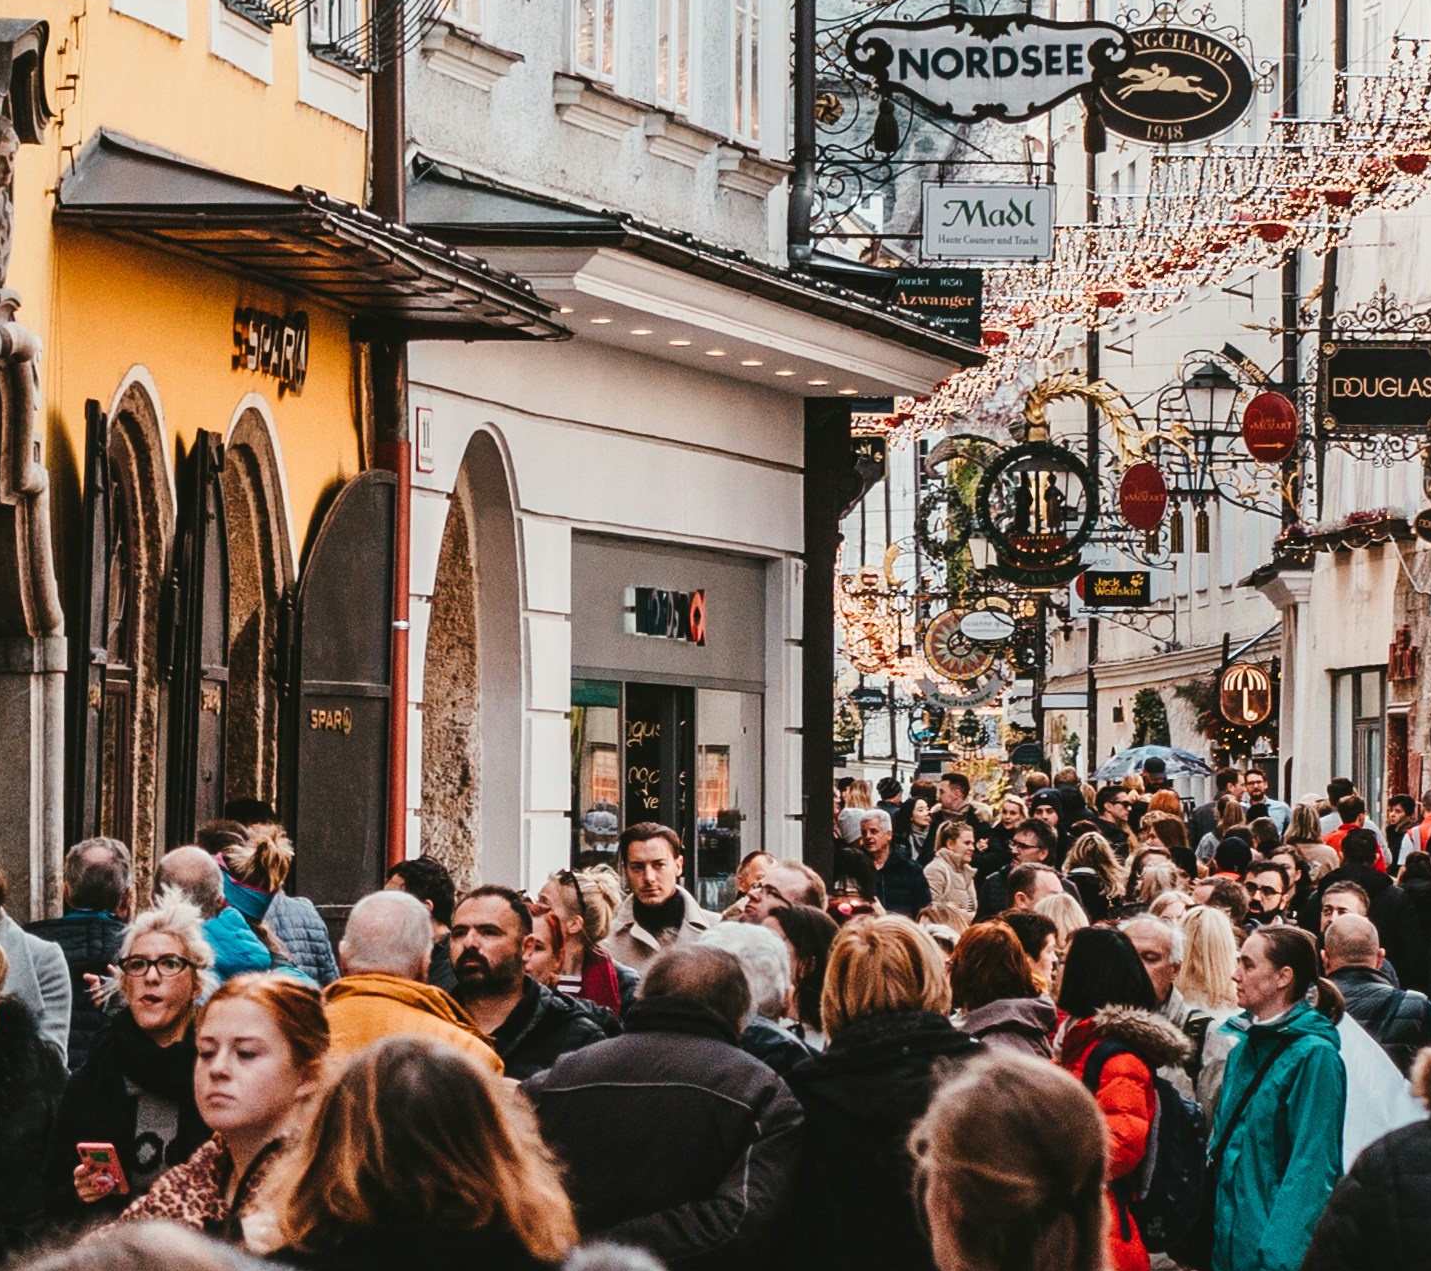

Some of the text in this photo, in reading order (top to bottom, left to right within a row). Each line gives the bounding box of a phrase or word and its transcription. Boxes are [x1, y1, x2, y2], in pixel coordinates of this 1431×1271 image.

[1131, 32, 1233, 65] NGCHAMP
[899, 43, 1084, 80] NORDSEE
[1146, 124, 1184, 140] 1948
[942, 198, 1036, 227] Madl
[938, 234, 962, 245] Haute
[896, 291, 975, 309] Azwanger
[1094, 577, 1120, 587] Jack
[1094, 586, 1142, 597] Wolfskin
[311, 709, 342, 729] SPAR
